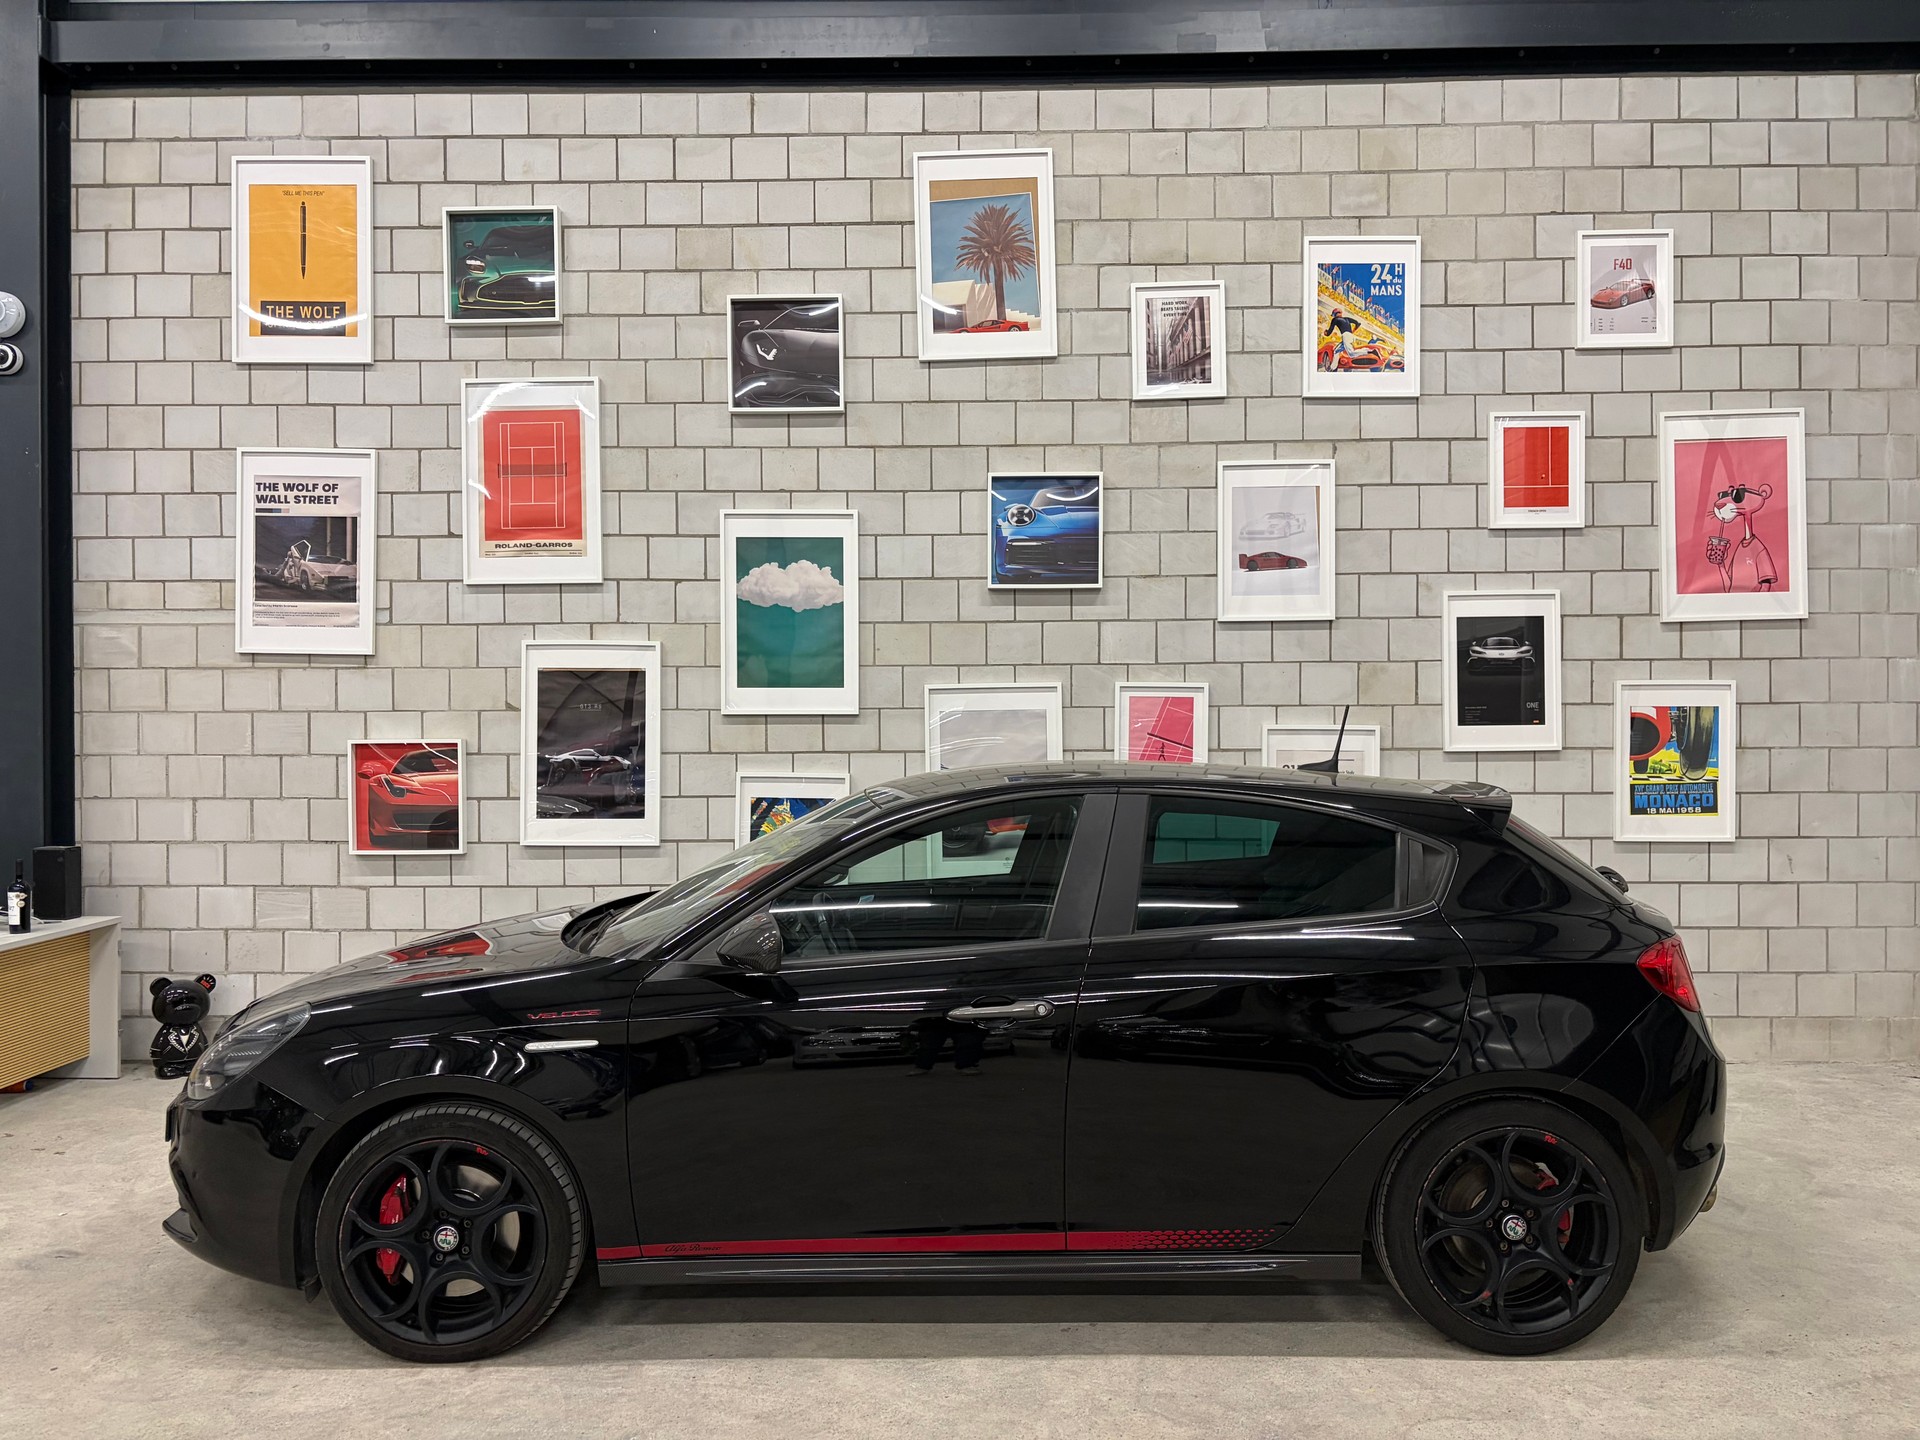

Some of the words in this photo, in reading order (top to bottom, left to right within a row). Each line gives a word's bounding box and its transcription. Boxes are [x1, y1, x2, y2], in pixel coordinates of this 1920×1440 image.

[1613, 258, 1632, 270] F40
[1370, 264, 1392, 284] 24
[1395, 264, 1402, 275] H
[1370, 285, 1402, 296] MANS
[266, 306, 294, 318] THE
[300, 306, 341, 319] WOLF
[256, 482, 279, 492] THE
[282, 482, 319, 493] WOLF
[322, 483, 339, 493] OF
[256, 494, 290, 504] WALL
[293, 495, 339, 505] STREET
[1680, 782, 1714, 792] AUTOMOBILE
[1634, 794, 1714, 808] MONACO
